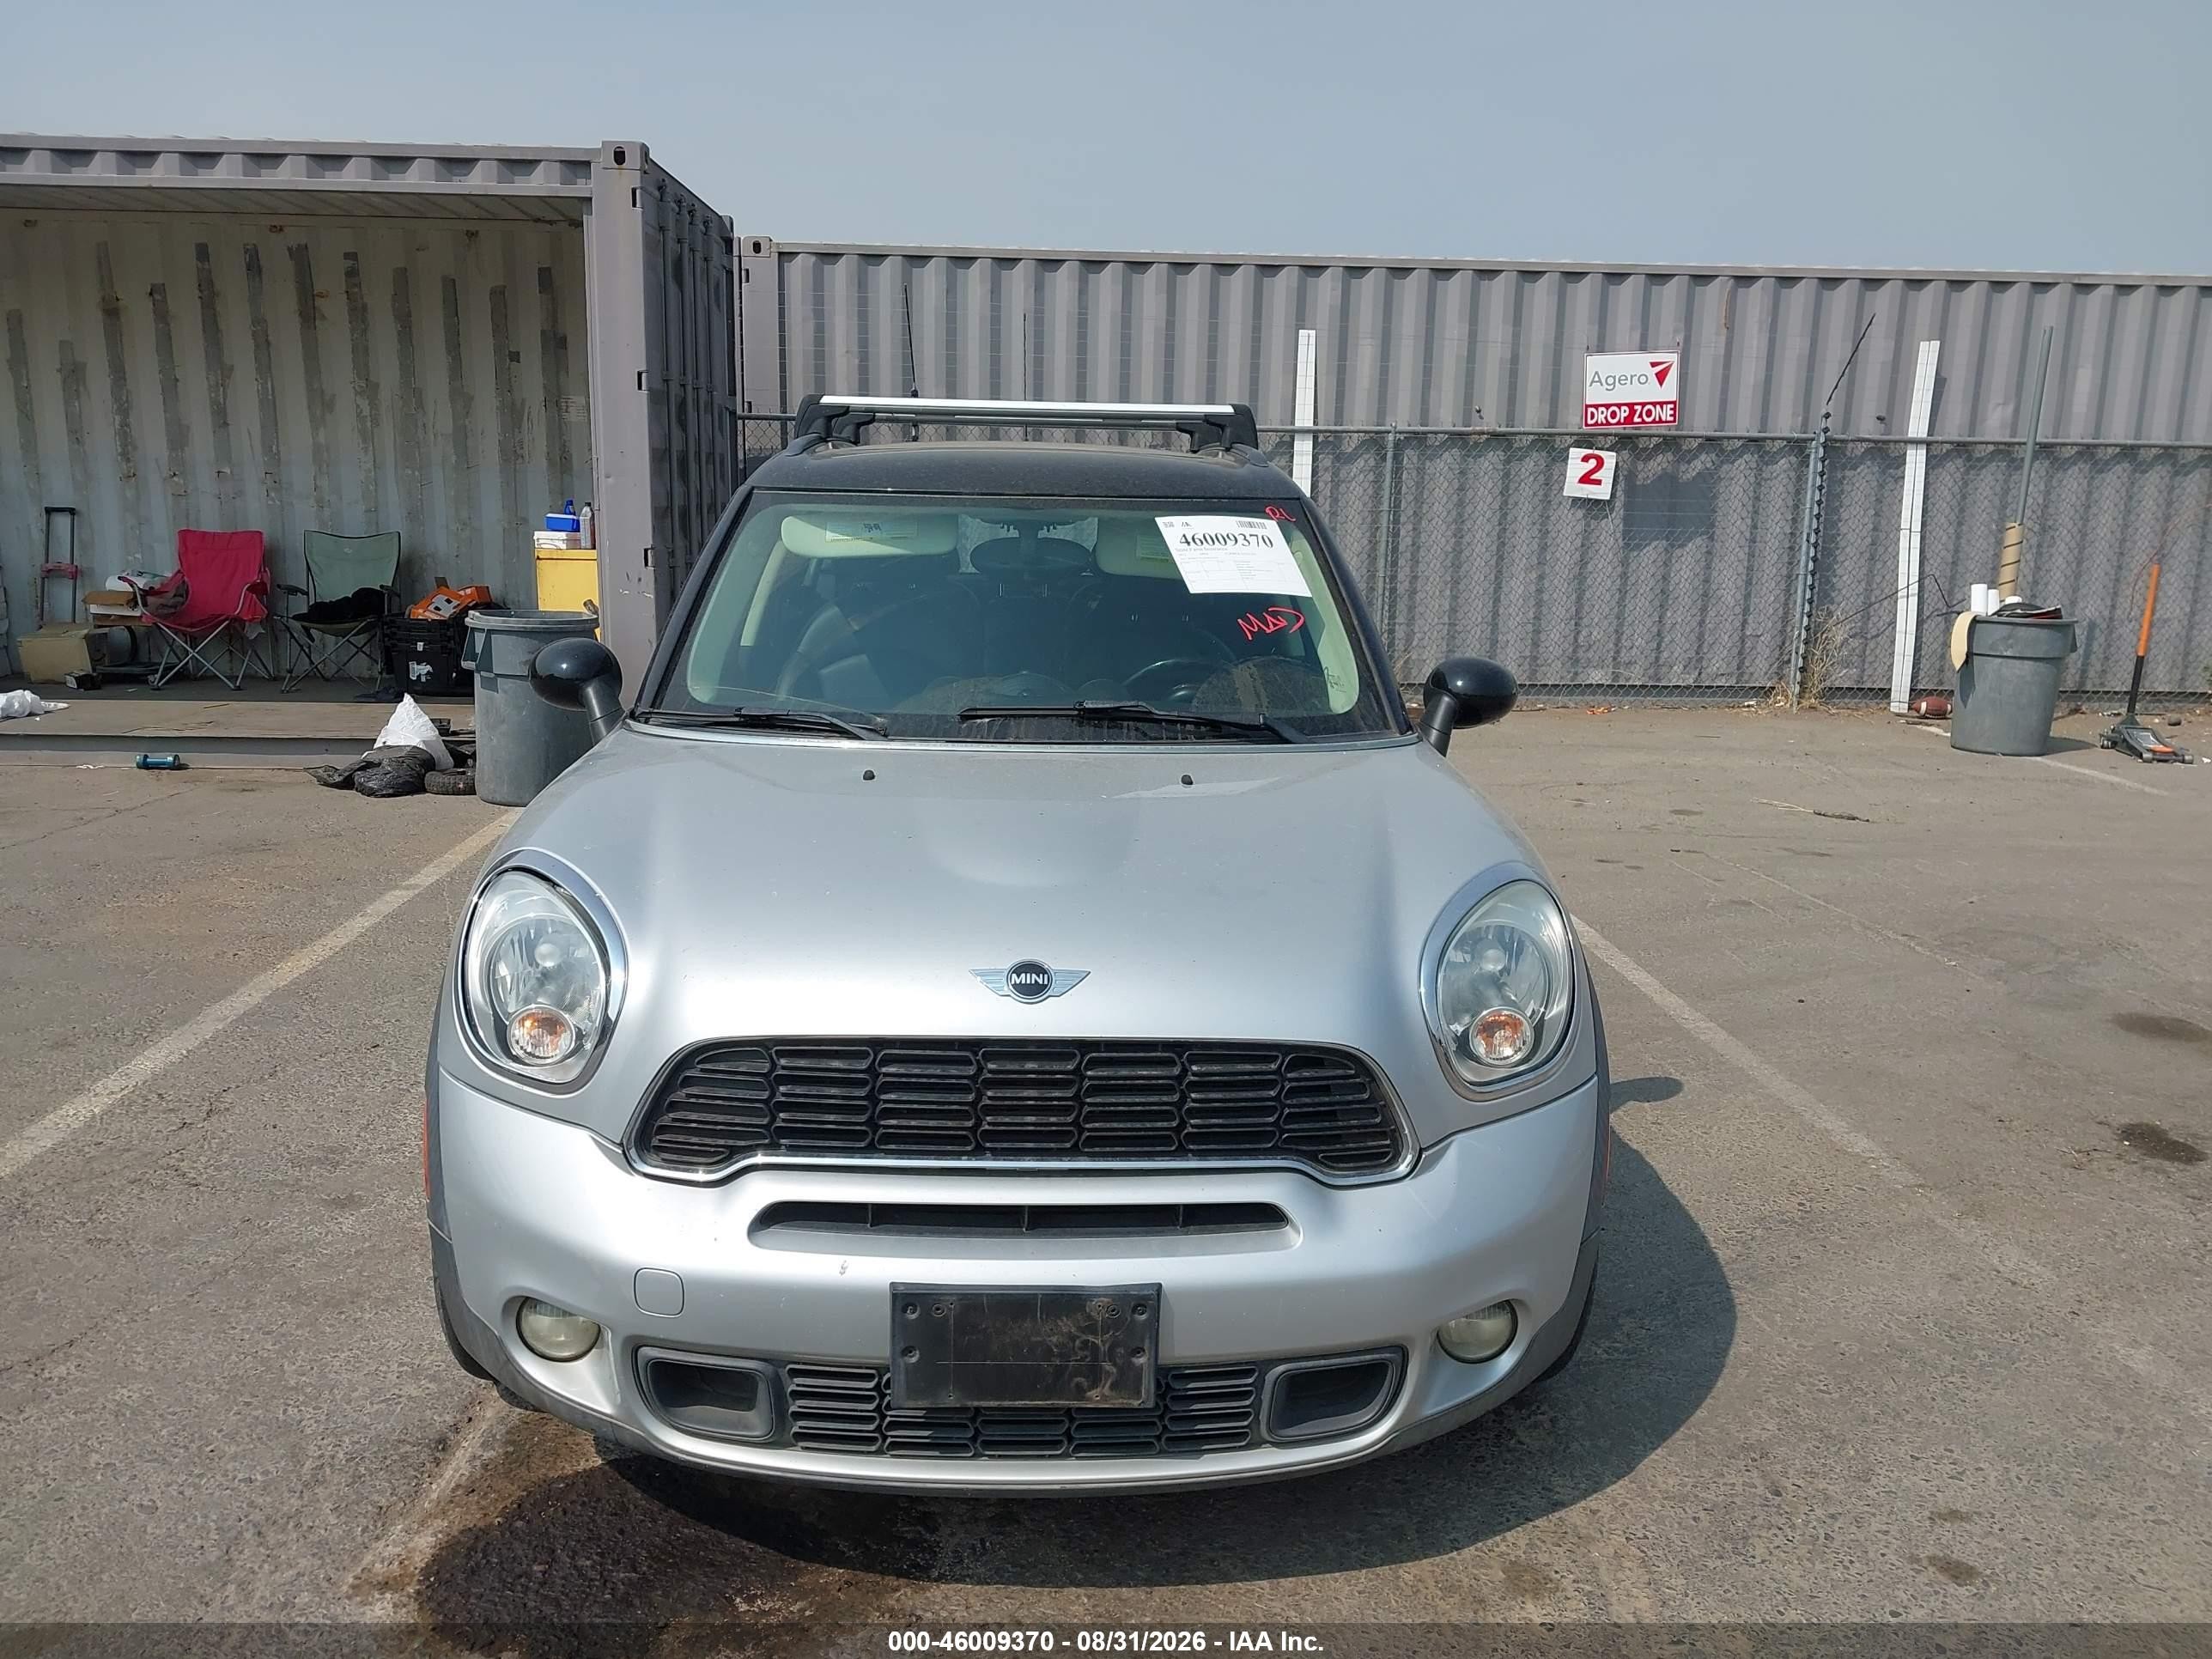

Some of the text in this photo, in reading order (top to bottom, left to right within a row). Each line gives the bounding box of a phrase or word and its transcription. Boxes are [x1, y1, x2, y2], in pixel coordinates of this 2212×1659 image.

[1589, 370, 1650, 392] Agero
[1587, 404, 1674, 424] DROP ZONE
[1577, 453, 1605, 486] 2
[1179, 532, 1274, 550] 46009370
[1011, 973, 1049, 985] MINI
